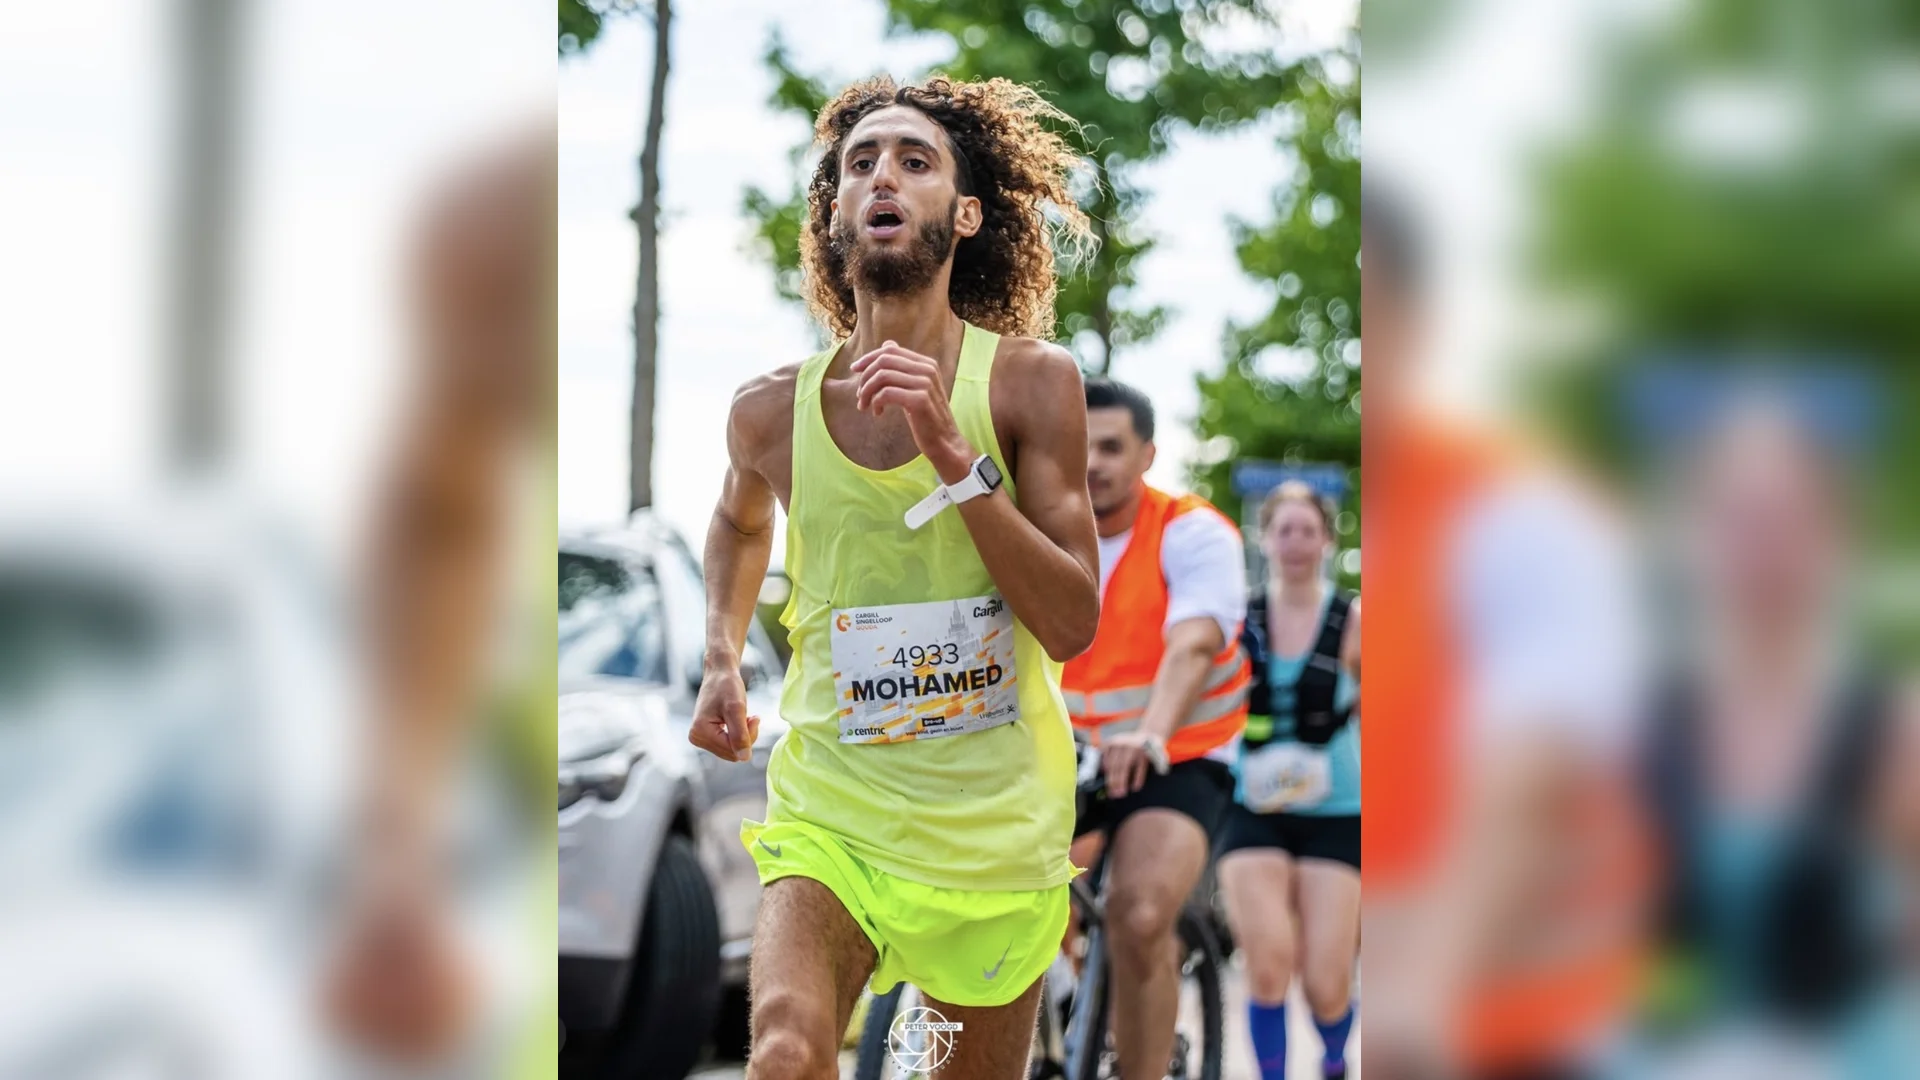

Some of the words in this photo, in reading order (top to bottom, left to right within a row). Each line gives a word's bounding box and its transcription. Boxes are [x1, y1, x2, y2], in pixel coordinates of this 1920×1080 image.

[973, 599, 1003, 618] Cargill
[855, 617, 893, 625] SINGELLOOP
[892, 643, 960, 668] 4933
[852, 663, 1003, 702] MOHAMED
[855, 727, 886, 736] centric
